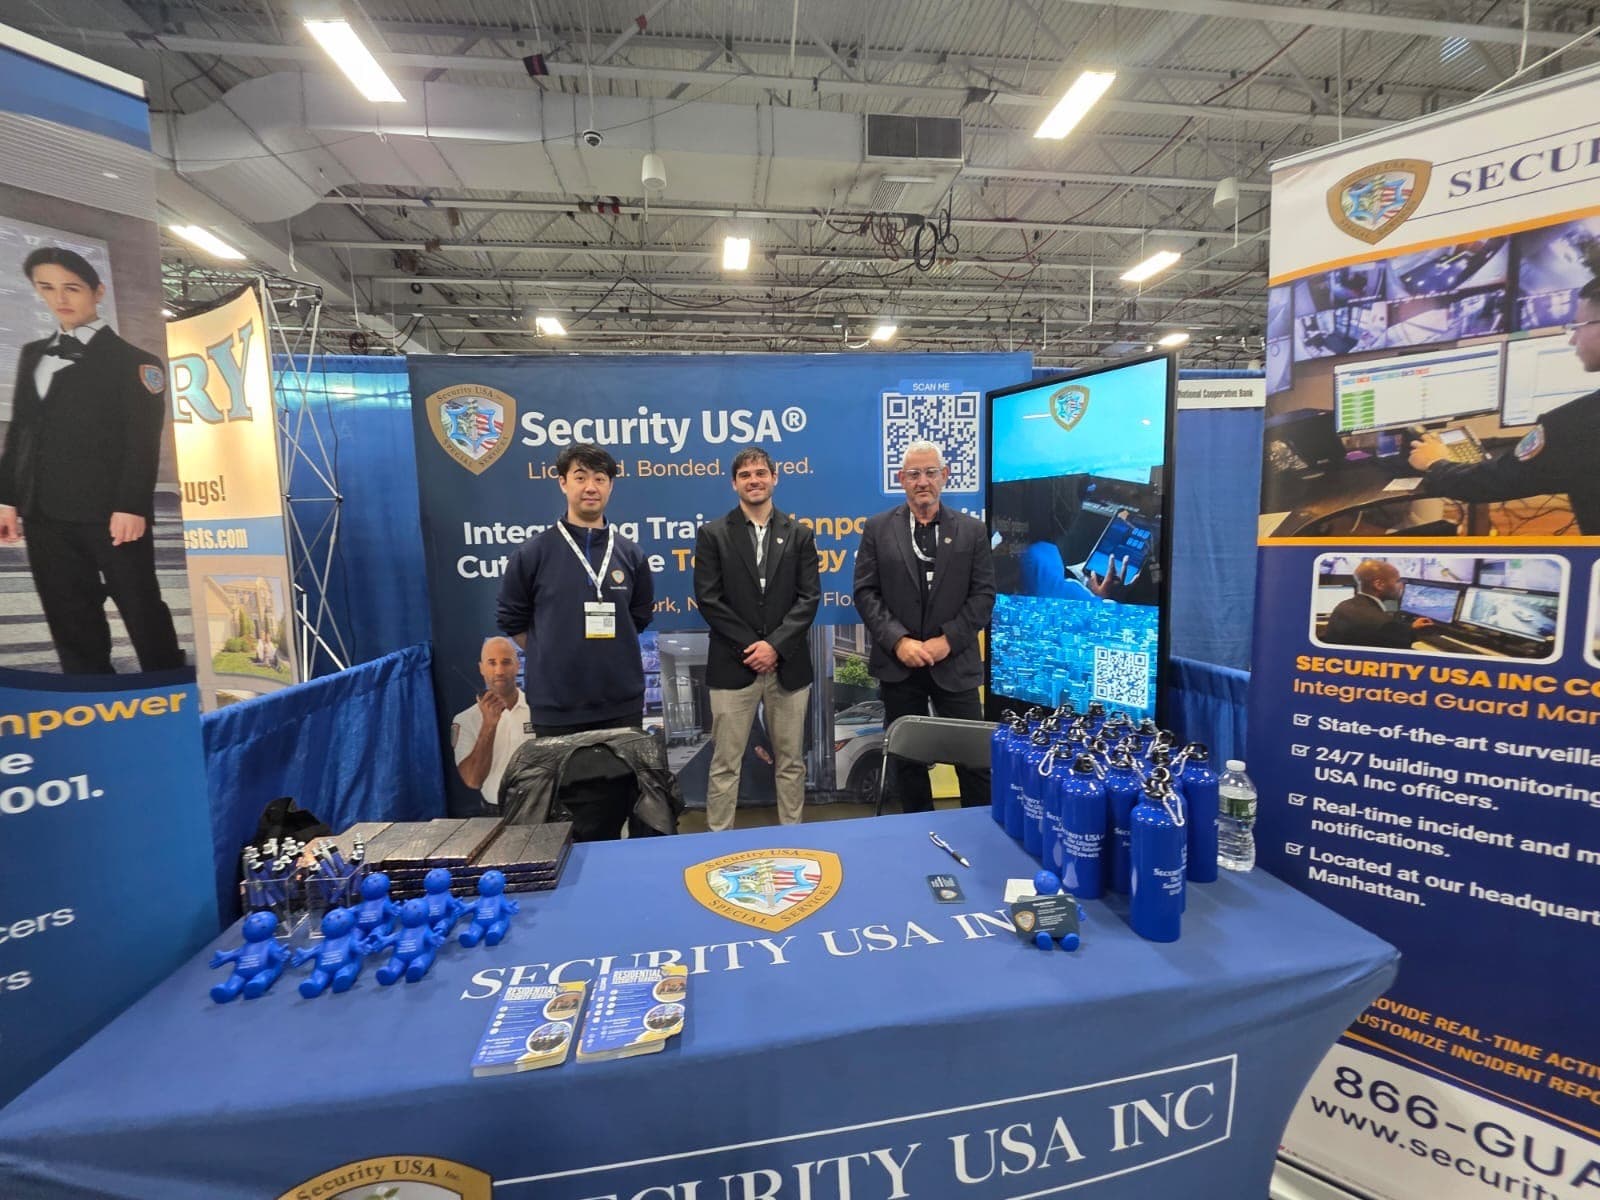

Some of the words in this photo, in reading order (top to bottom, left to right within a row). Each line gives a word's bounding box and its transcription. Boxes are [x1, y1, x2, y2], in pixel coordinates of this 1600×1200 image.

[912, 383, 936, 391] SCAN
[938, 382, 951, 391] ME
[521, 406, 691, 454] Security
[638, 457, 726, 477] Bonded.
[180, 474, 227, 506] ugs!
[1296, 655, 1425, 681] SECURITY
[1430, 667, 1492, 689] USA
[1498, 672, 1558, 694] INC
[1293, 678, 1427, 707] Integrated
[1434, 693, 1529, 718] Guard
[1317, 716, 1489, 753] State-of-the-art
[1316, 747, 1364, 766] 24/7
[1369, 754, 1459, 785] building
[1314, 766, 1358, 787] USA
[1363, 774, 1397, 793] Inc
[1401, 783, 1500, 811] officers.
[1311, 817, 1451, 858] notifications.
[1312, 797, 1413, 829] Real-time
[1417, 816, 1515, 849] incident
[1520, 839, 1571, 859] and
[704, 850, 766, 870] Security
[770, 849, 799, 857] USA
[1309, 847, 1392, 877] Located
[1397, 866, 1420, 884] at
[1424, 874, 1465, 894] our
[708, 898, 769, 926] SPECIAL
[780, 883, 834, 923] SERVICES
[1308, 866, 1427, 907] Manhattan.
[817, 920, 945, 958] USA
[950, 908, 1018, 941] IN
[1356, 1013, 1448, 1054] USTOMIZE
[1450, 1044, 1546, 1084] INCIDENT
[1371, 997, 1433, 1026] OVIDE
[1433, 1016, 1544, 1061] REAL-TIME
[947, 1116, 1086, 1185] USA
[1108, 1081, 1215, 1153] INC
[1310, 1095, 1562, 1200] www.securit
[295, 1162, 386, 1200] Security
[393, 1159, 437, 1178] USA
